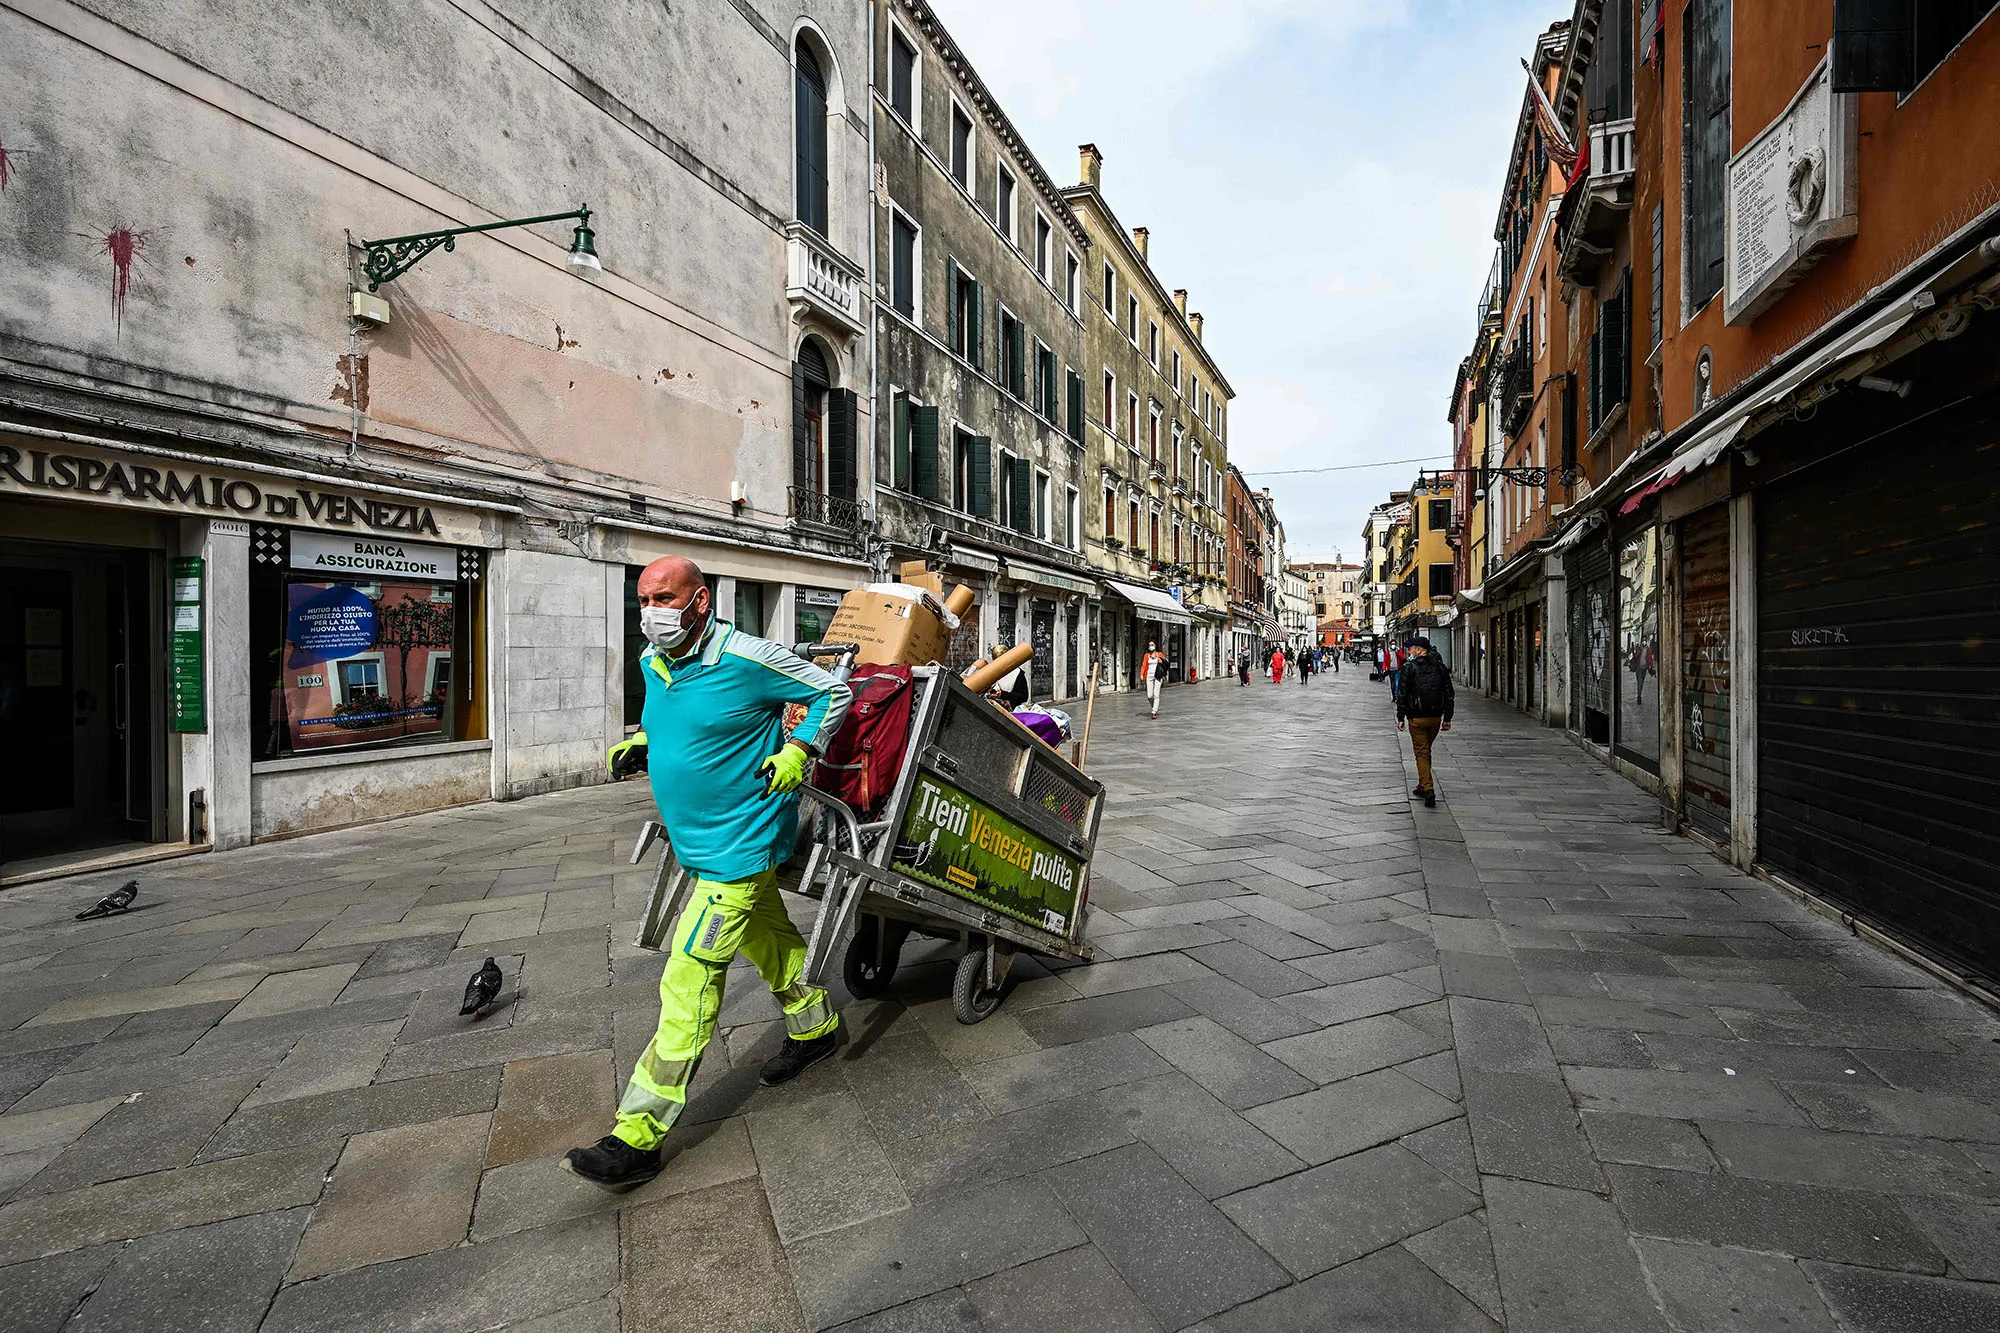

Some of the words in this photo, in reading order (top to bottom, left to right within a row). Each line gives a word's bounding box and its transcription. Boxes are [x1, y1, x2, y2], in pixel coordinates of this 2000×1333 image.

[264, 494, 298, 517] DI
[296, 490, 441, 534] VENEZIA
[354, 542, 405, 558] BANCA
[315, 554, 436, 574] ASSICURAZIONE
[300, 676, 321, 685] 100
[916, 780, 970, 837] Tieni
[969, 809, 1032, 871] Venezia
[1031, 852, 1074, 891] pulita
